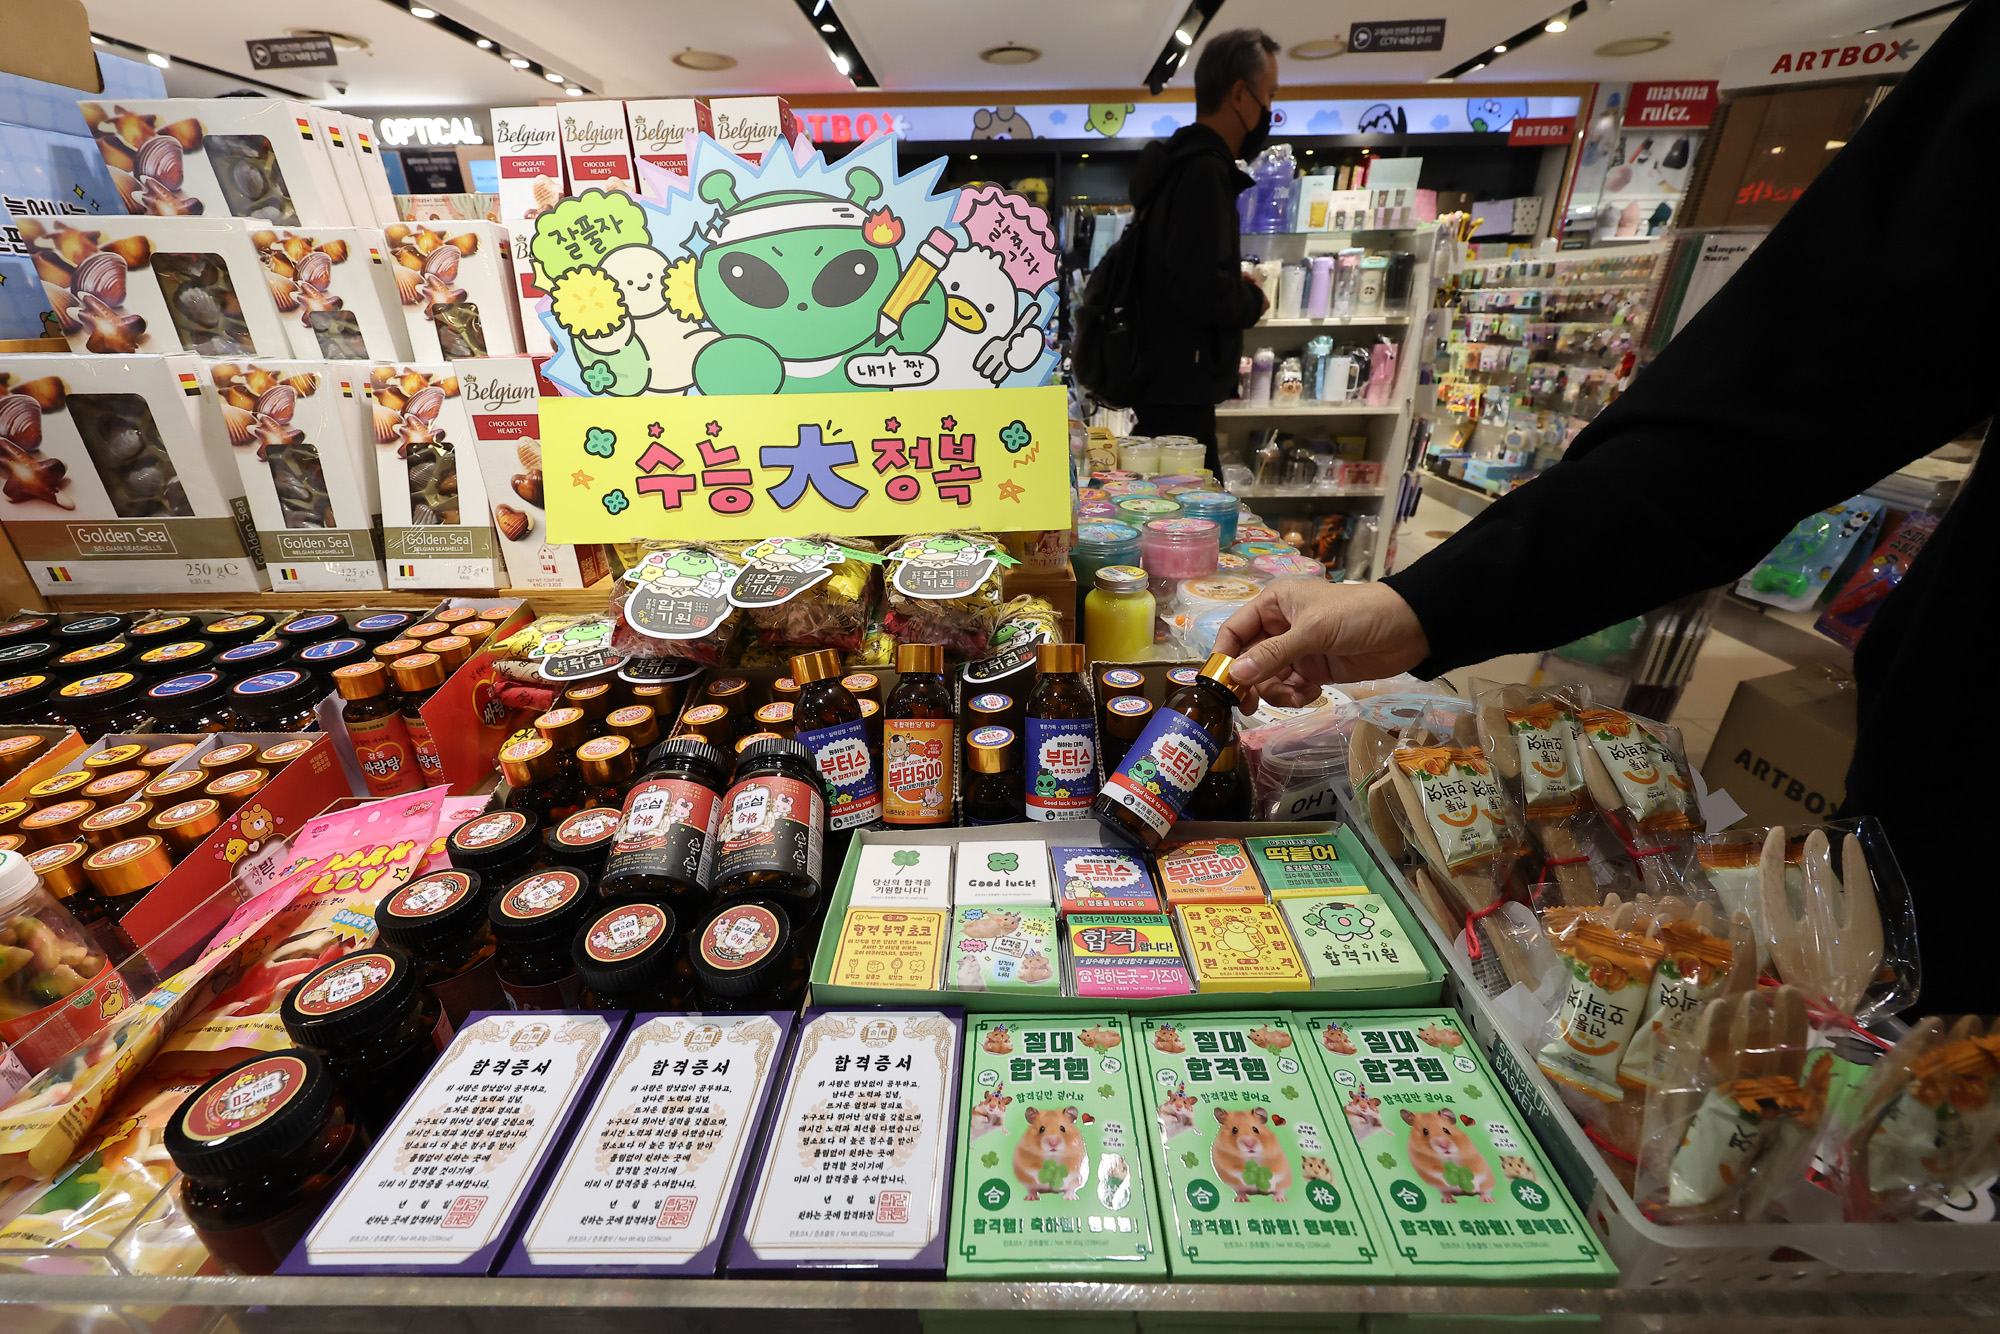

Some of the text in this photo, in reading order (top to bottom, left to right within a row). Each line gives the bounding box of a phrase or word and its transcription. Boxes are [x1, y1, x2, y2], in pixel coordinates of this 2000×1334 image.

[1771, 39, 1920, 74] ARTBOX
[1646, 85, 1709, 101] masma
[1641, 104, 1690, 121] rulez.
[380, 117, 483, 145] OPTICAL
[498, 123, 556, 152] Belgian
[565, 121, 624, 152] Belgian
[718, 119, 778, 149] Belgian
[548, 211, 624, 259] 잘풀자
[988, 211, 1041, 276] 잘찍자
[856, 359, 925, 378] 내가 짱
[463, 378, 536, 411] Belgian
[488, 420, 528, 428] CHOCOLATE
[77, 527, 168, 543] Golden Sea
[236, 500, 266, 566] Golden Sea
[407, 532, 470, 546] Golden Sea
[283, 536, 349, 549] Golden Sea
[186, 563, 212, 577] 250
[457, 565, 473, 575] 125
[754, 573, 783, 585] 합격
[922, 569, 955, 580] 합격
[750, 584, 779, 596] 기원
[922, 578, 954, 589] 기원
[658, 600, 693, 612] 합격
[657, 611, 691, 626] 기원
[1527, 733, 1563, 752] 호박엿
[1045, 748, 1091, 767] 부터스
[1606, 743, 1649, 761] 호박엿
[363, 756, 401, 776] 싸랑탕
[821, 750, 867, 774] 부터스
[1157, 741, 1200, 783] 부터스
[888, 761, 942, 792] 부터500
[1129, 783, 1156, 804] Good luck
[1424, 780, 1468, 802] 호박엿
[633, 814, 654, 827] 合格
[736, 812, 757, 825] 合格
[1265, 845, 1337, 862] 딱붙어
[1075, 863, 1133, 877] 부터스
[1166, 856, 1247, 885] 부터500
[872, 878, 932, 887] 당신의 합격을
[875, 886, 927, 895] 기원합니다!
[968, 879, 1036, 888] Good luck!
[1087, 899, 1136, 907] 행운을 빌어요
[1073, 915, 1164, 924] 합격기원/만점신화
[854, 923, 931, 936] 합격 부적 초코
[1081, 928, 1174, 953] 합격 합니다!
[1323, 948, 1400, 966] 합격기원
[1567, 983, 1629, 1026] 호박엿
[1023, 1031, 1074, 1054] 절대
[1192, 1031, 1247, 1053] 절대
[1361, 1030, 1420, 1054] 절대
[470, 1058, 552, 1077] 합격증서
[651, 1058, 730, 1077] 합격증서
[834, 1054, 913, 1072] 합격증서
[1009, 1057, 1090, 1082] 합격햄
[1185, 1056, 1270, 1082] 합격햄
[1359, 1057, 1450, 1083] 합격햄
[828, 1080, 920, 1088] 사람은 밤낮없이 공부하고,
[1495, 1056, 1535, 1116] BASKET
[1499, 1042, 1550, 1117] SENSE-UP
[832, 1091, 881, 1099] 남다른 노력과
[1016, 1090, 1053, 1104] 합격길만
[1200, 1090, 1272, 1104] 합격길만 걸어요
[1382, 1092, 1456, 1105] 합격길만 걸어요
[826, 1101, 903, 1109] 뜨거운 열정과 열의로
[801, 1113, 924, 1122] 누구보다 뛰어난 실력을 갖췄으며,
[799, 1125, 922, 1133] 매시간 노력과 최선을 다했습니다.
[802, 1136, 915, 1145] 평소보다 높은 점수를 받아
[813, 1149, 895, 1158] 틀림없이 원하는 곳에
[822, 1161, 884, 1171] 합격할 것이기에
[793, 1175, 907, 1184] 미리 합격증을 수여합니다.
[983, 1186, 1005, 1204] 合
[1191, 1186, 1213, 1204] 合
[1313, 1186, 1335, 1207] 格
[1397, 1187, 1420, 1206] 合
[1518, 1185, 1543, 1205] 格
[798, 1210, 874, 1220] 원하는 곳에 합격하장
[973, 1218, 1083, 1235] 합격햄! 축하햄!
[1189, 1219, 1241, 1235] 합격햄!
[1246, 1219, 1298, 1236] 축하햄!
[1399, 1219, 1456, 1236] 합격햄!
[1458, 1219, 1512, 1237] 축하햄!
